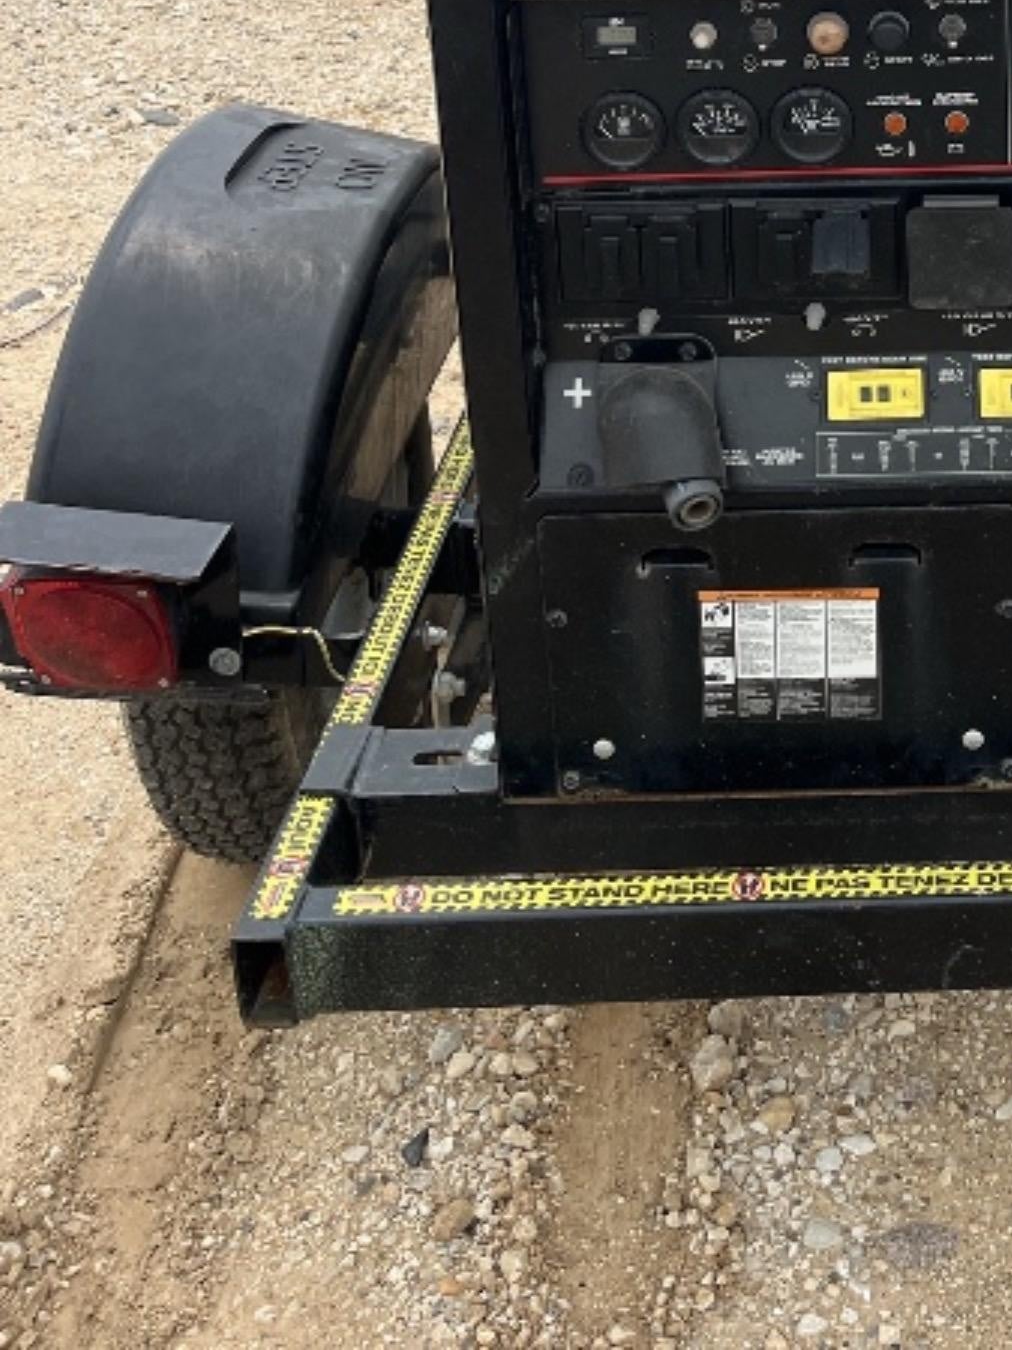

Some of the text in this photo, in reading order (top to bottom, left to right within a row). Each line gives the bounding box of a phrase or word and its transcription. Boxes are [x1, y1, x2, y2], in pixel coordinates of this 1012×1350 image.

[431, 878, 730, 903] DO NOT STAND HERE
[770, 877, 808, 892] NE
[815, 876, 870, 891] PAS
[880, 873, 969, 890] TENEZ
